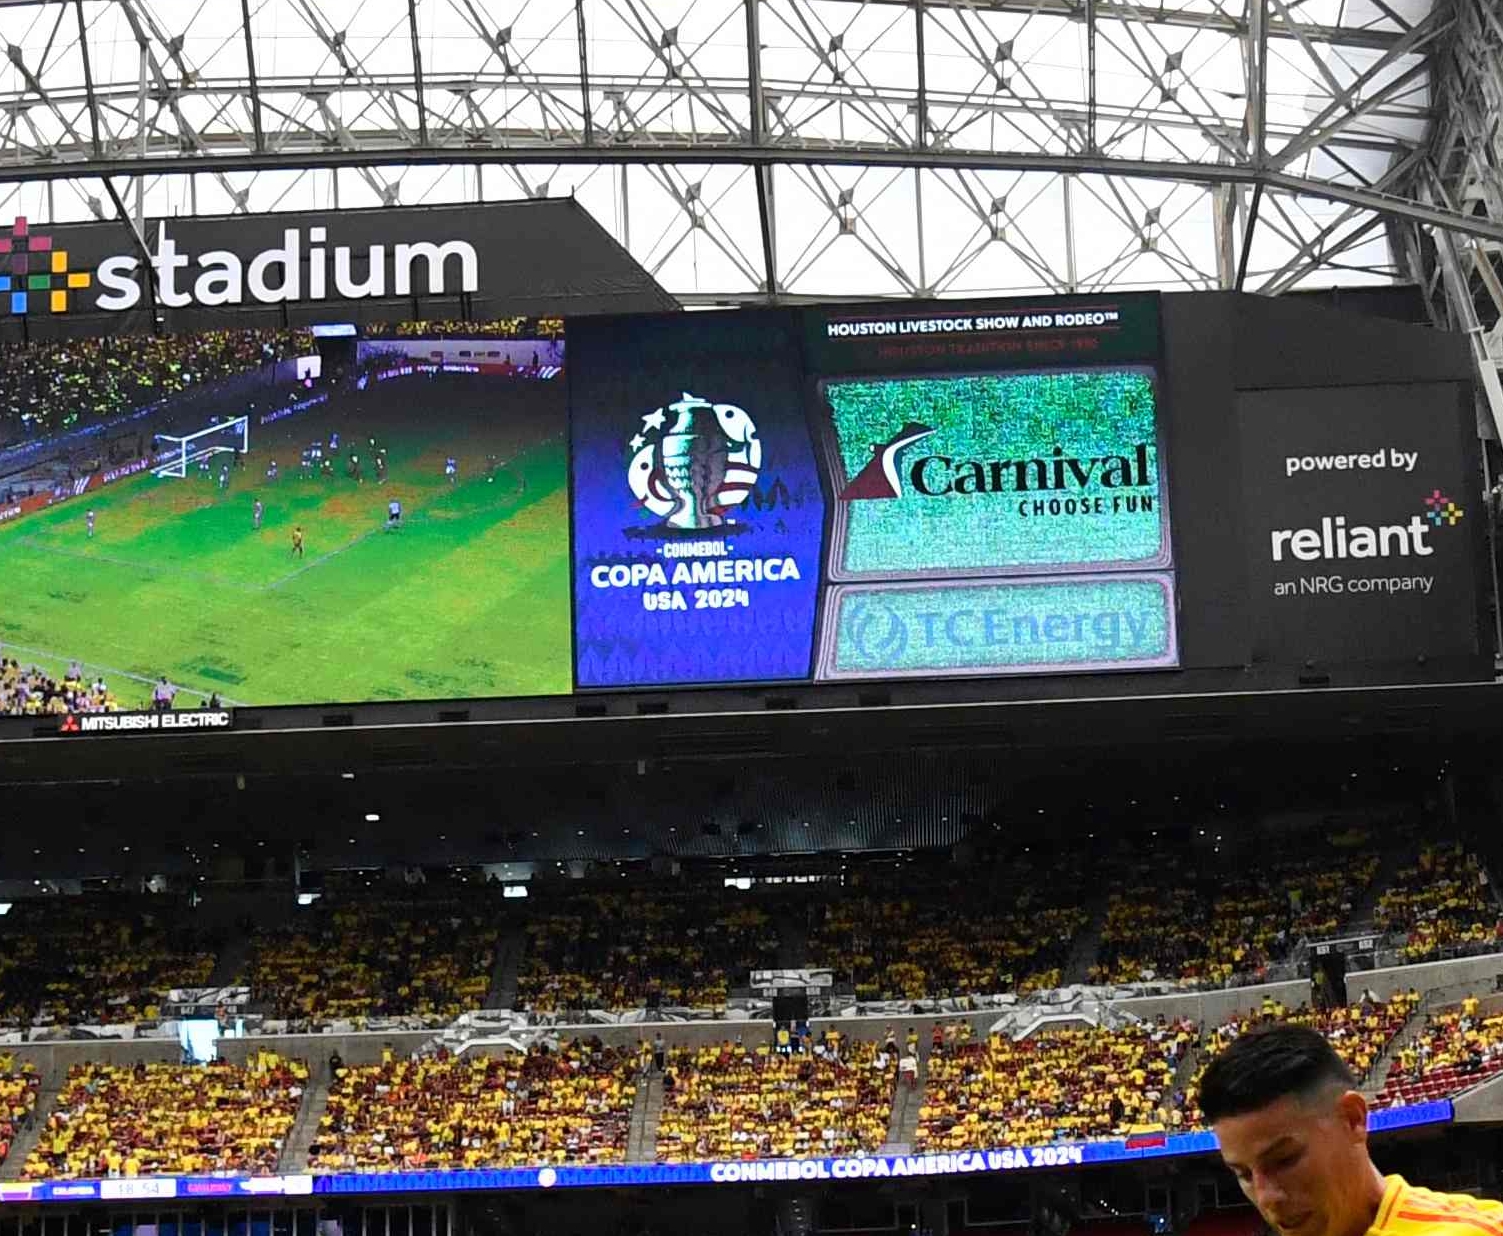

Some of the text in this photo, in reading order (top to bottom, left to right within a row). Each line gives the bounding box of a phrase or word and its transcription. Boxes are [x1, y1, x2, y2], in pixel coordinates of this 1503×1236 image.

[97, 220, 478, 312] stadium
[828, 322, 897, 338] HOUSTON
[899, 318, 973, 334] LIVESTOCK
[975, 316, 1019, 330] SHOW
[1022, 314, 1052, 328] AND
[910, 444, 1150, 497] Carnival
[1285, 447, 1419, 477] powered by
[1019, 495, 1154, 517] CHOOSE FUN
[1271, 515, 1435, 562] reliant
[590, 557, 801, 588] COPA AMERICA
[1273, 575, 1435, 596] an NRG company
[642, 588, 750, 611] USA 2024
[81, 712, 230, 731] MITSUBISHI ELECTRIC
[710, 1147, 1083, 1182] CONMEBOL COPA AMERICA USA 2024
